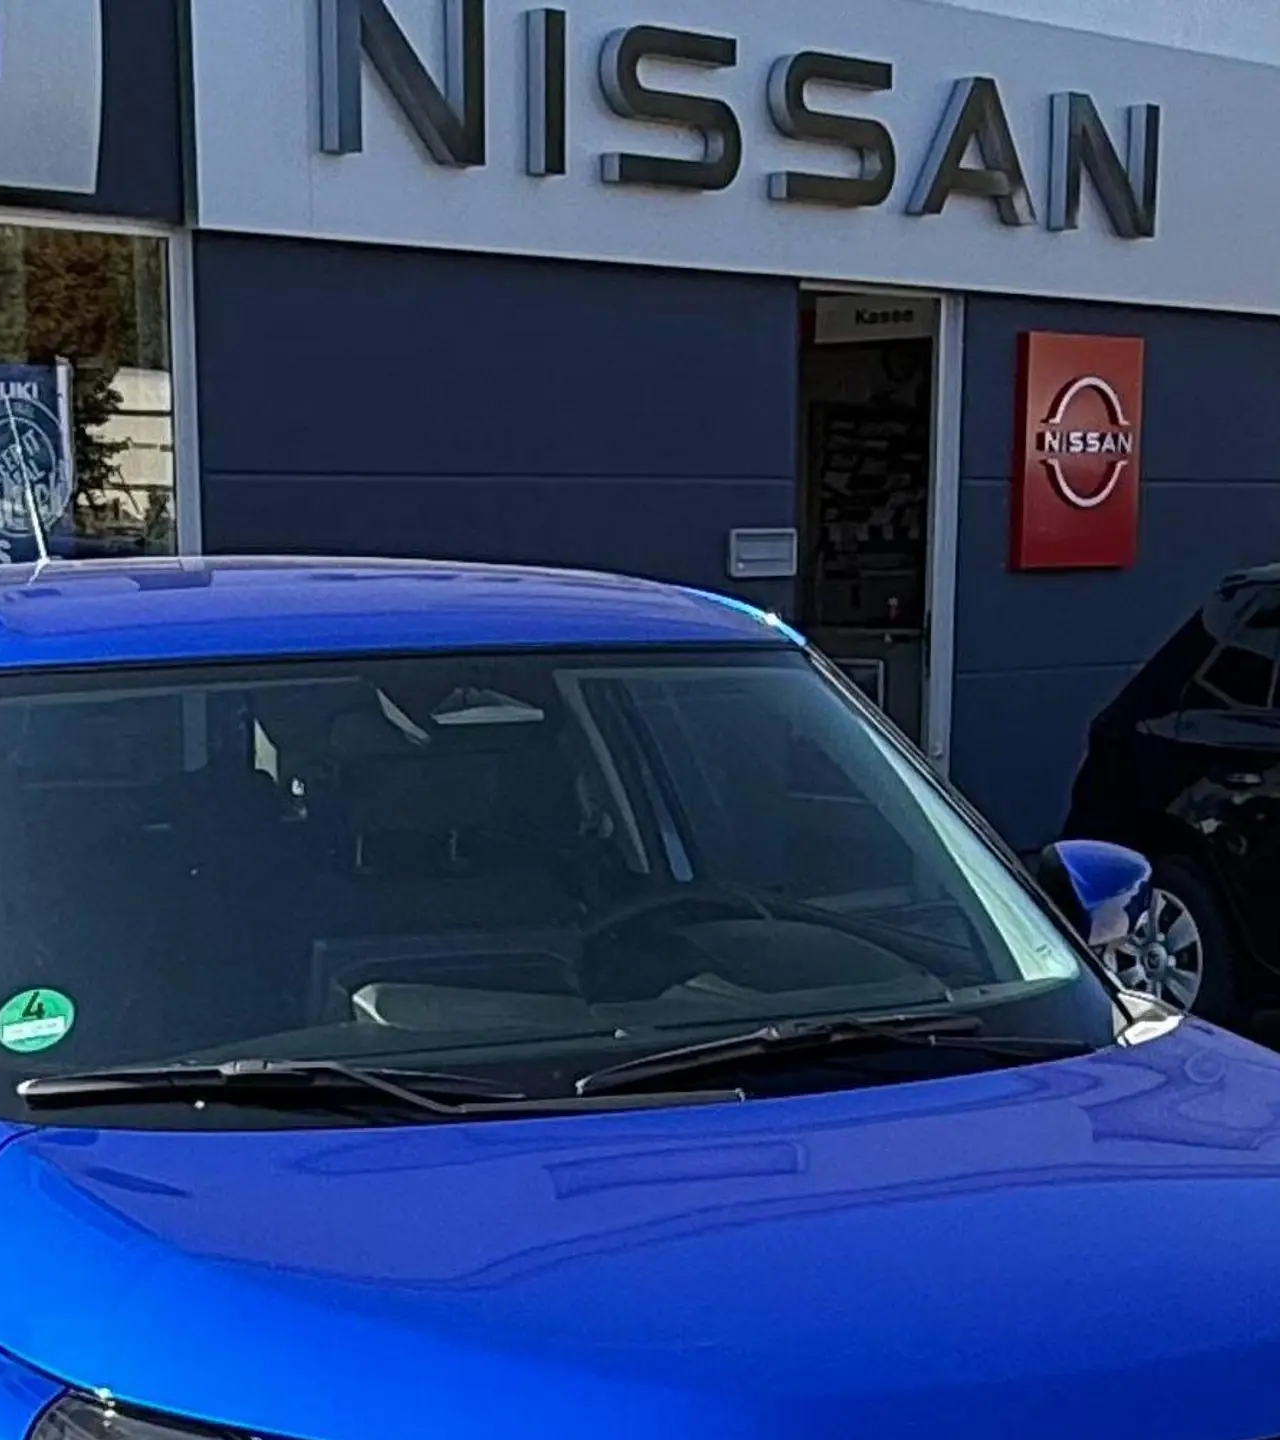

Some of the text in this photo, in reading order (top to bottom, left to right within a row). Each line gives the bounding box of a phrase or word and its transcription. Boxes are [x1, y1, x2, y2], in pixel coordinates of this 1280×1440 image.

[320, 0, 1160, 238] NISSAN
[1044, 431, 1133, 454] NISSAN
[22, 990, 45, 1019] 4
